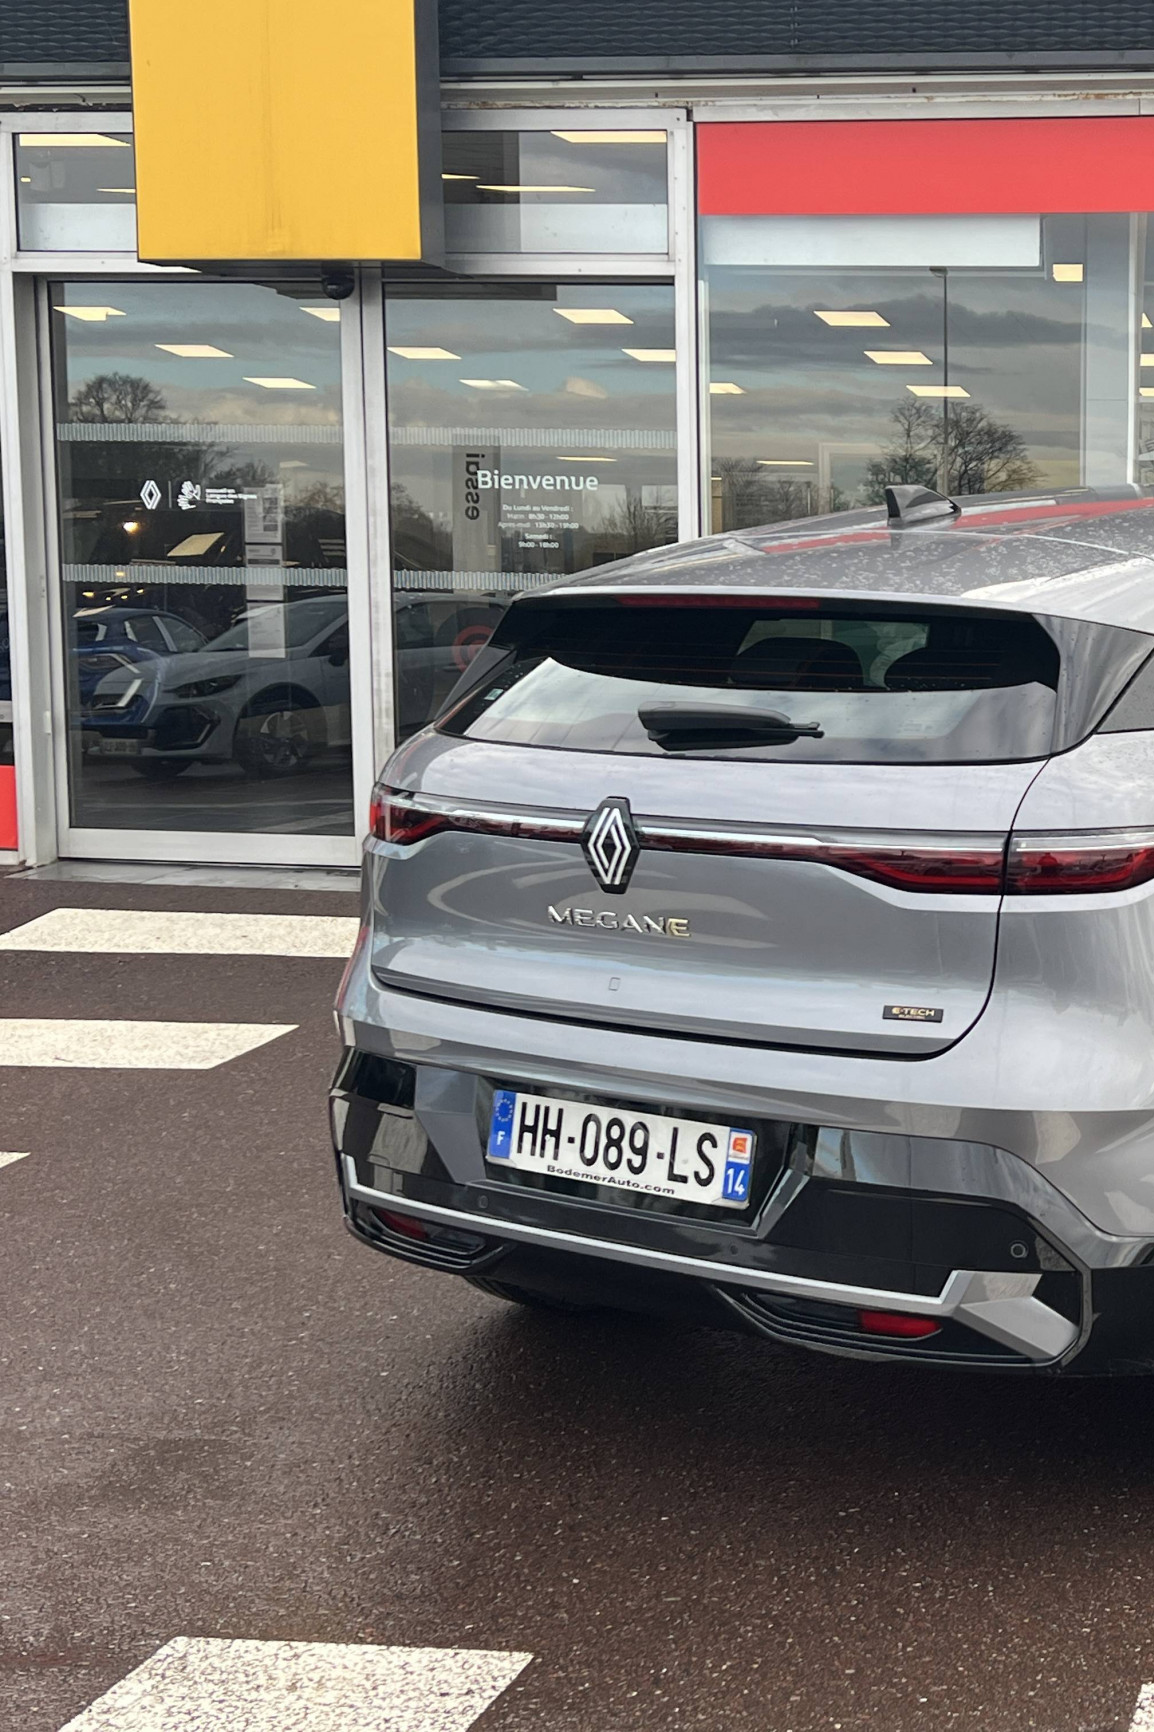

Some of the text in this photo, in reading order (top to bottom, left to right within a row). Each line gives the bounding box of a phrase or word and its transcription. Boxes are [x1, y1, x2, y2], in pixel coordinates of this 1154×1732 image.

[477, 469, 599, 491] Bienvenue
[549, 513, 569, 521] 12h00
[539, 541, 559, 549] 18h00
[547, 904, 692, 937] MEGANE
[496, 1101, 746, 1196] F HH-089-LS 14
[546, 1164, 676, 1195] BodemerAuto.com
